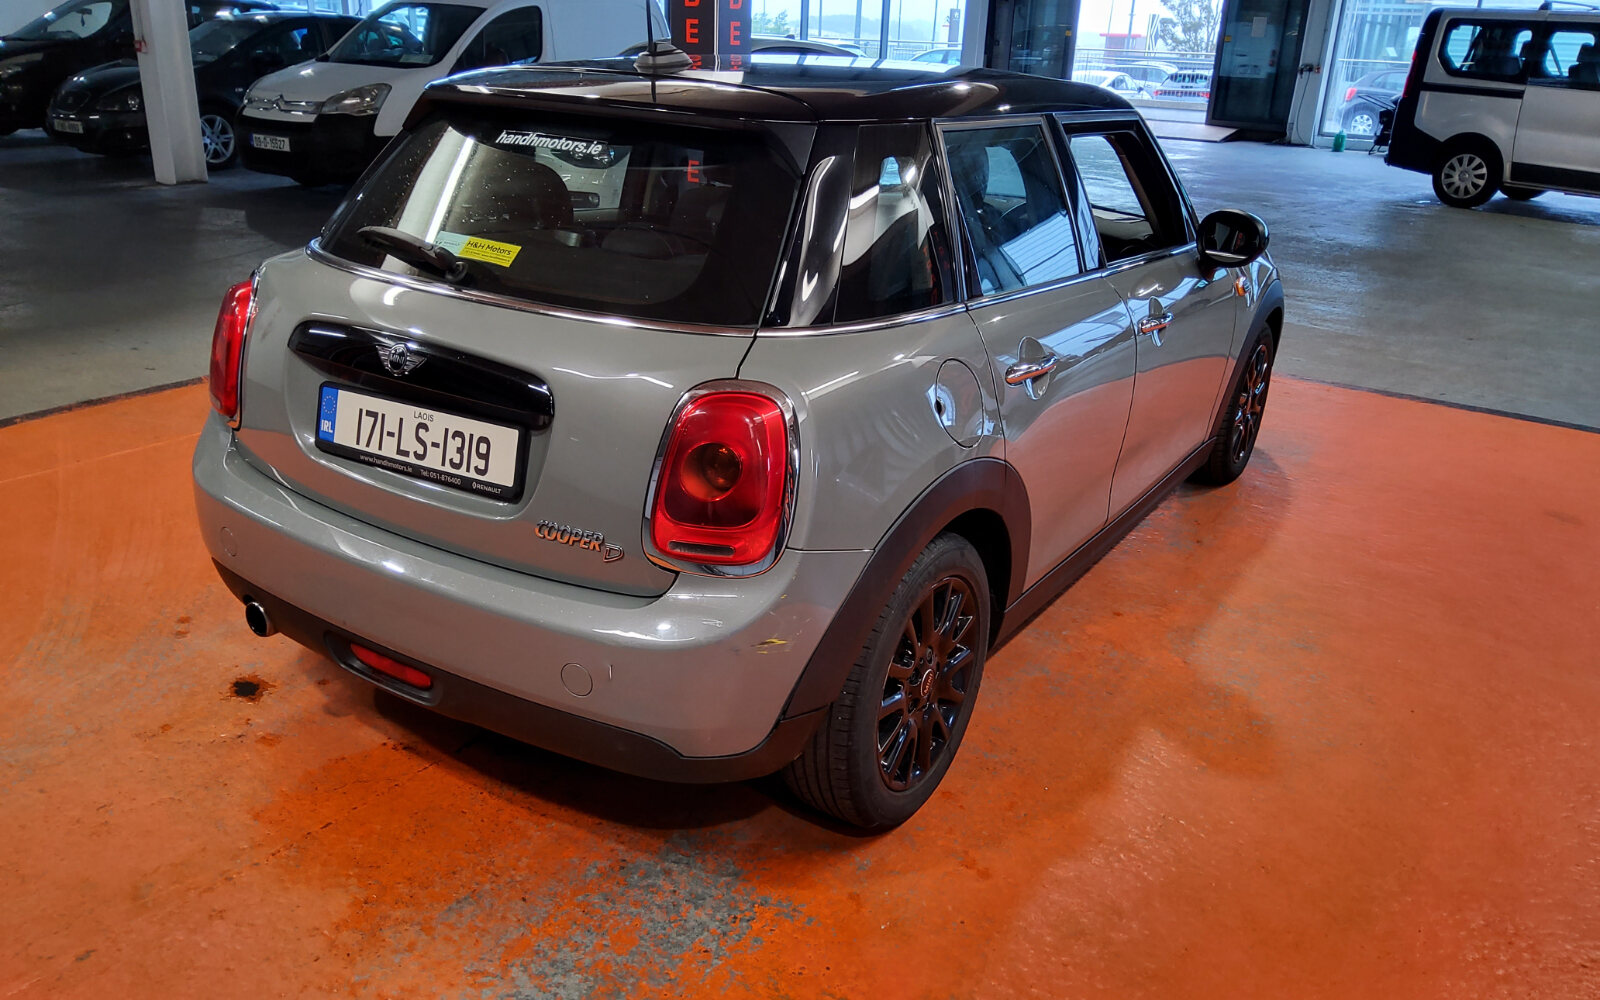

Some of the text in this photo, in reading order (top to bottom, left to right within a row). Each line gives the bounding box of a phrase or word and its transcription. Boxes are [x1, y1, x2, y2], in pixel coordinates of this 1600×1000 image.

[496, 130, 603, 155] handhmotors.ie
[467, 240, 485, 250] H&H
[486, 244, 512, 256] Motors
[320, 419, 334, 433] IRL
[413, 410, 434, 422] LAOIS
[355, 407, 492, 477] 171-LS-1319
[359, 454, 413, 473] www.handhmotors.ie
[430, 471, 462, 485] 051-876400
[476, 483, 502, 495] RENAULT
[534, 519, 624, 563] COOPER D
[924, 673, 933, 693] MINI
